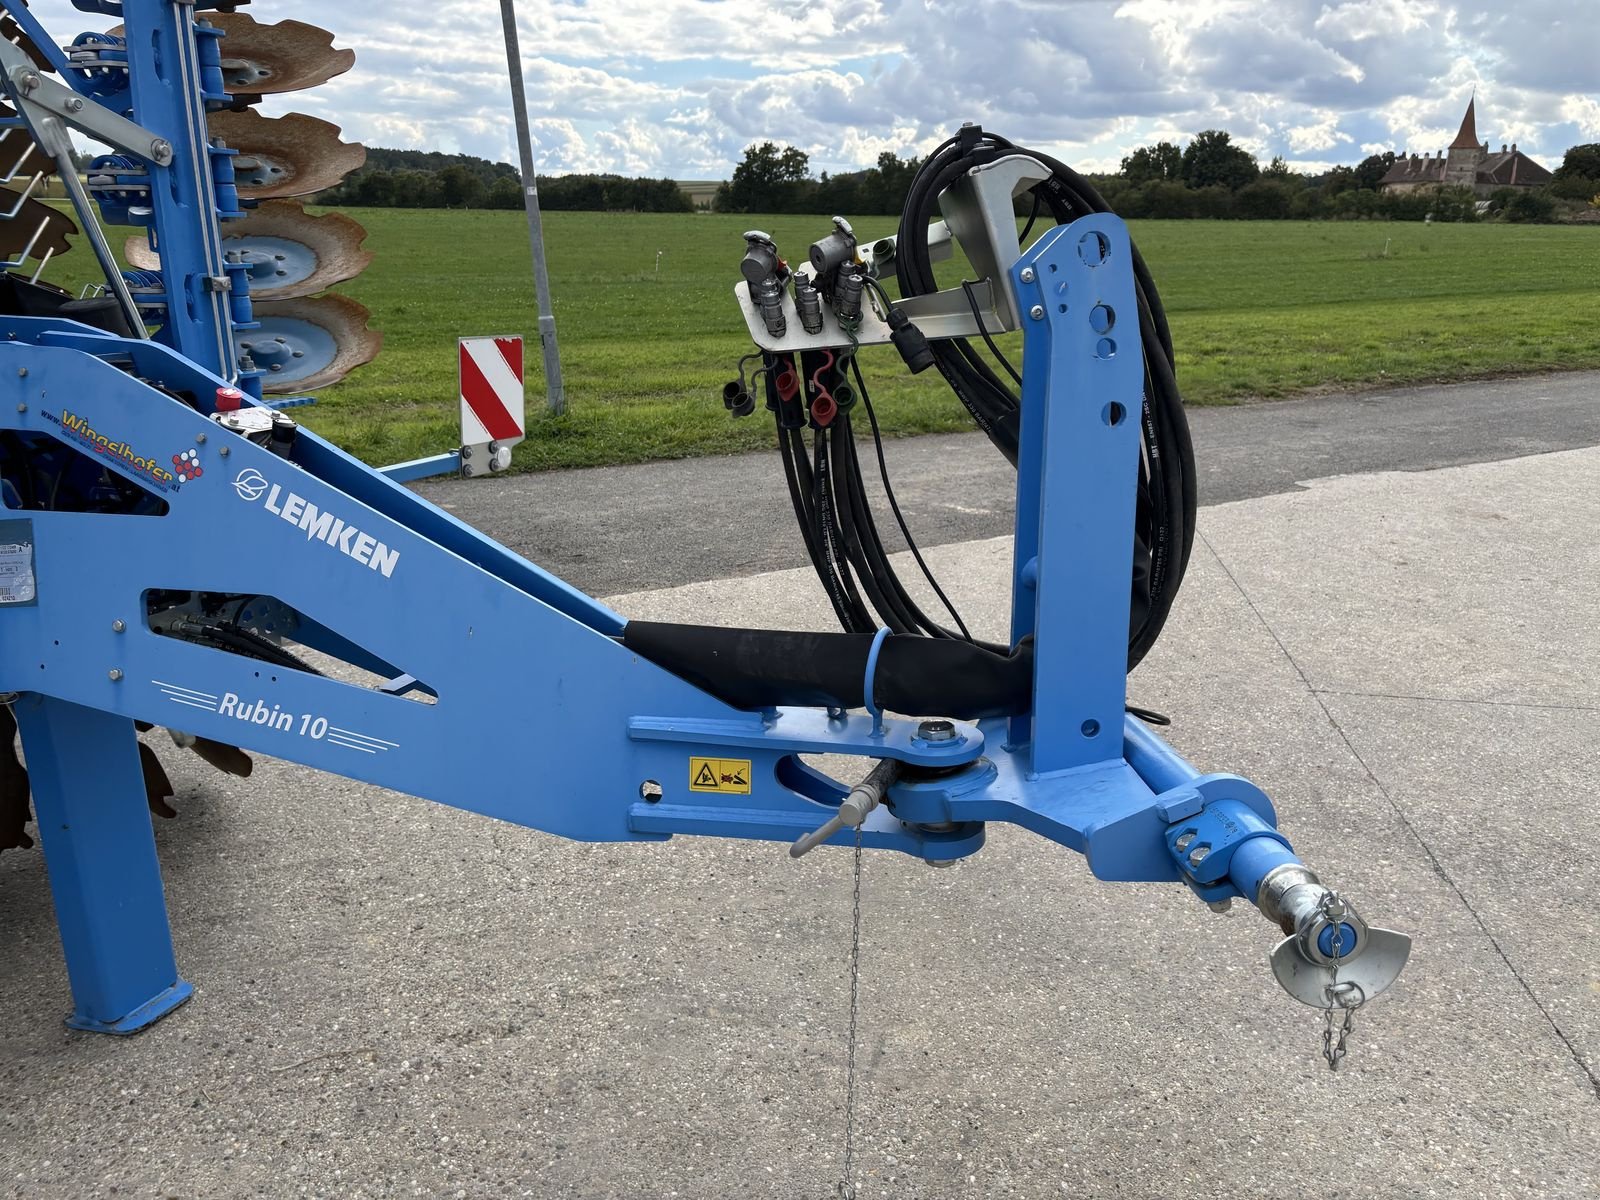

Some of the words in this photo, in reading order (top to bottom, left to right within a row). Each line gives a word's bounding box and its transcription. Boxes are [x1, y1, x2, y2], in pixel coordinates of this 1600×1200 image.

[263, 482, 401, 579] LEMKEN
[218, 692, 294, 733] Rubin
[299, 713, 329, 741] 10
